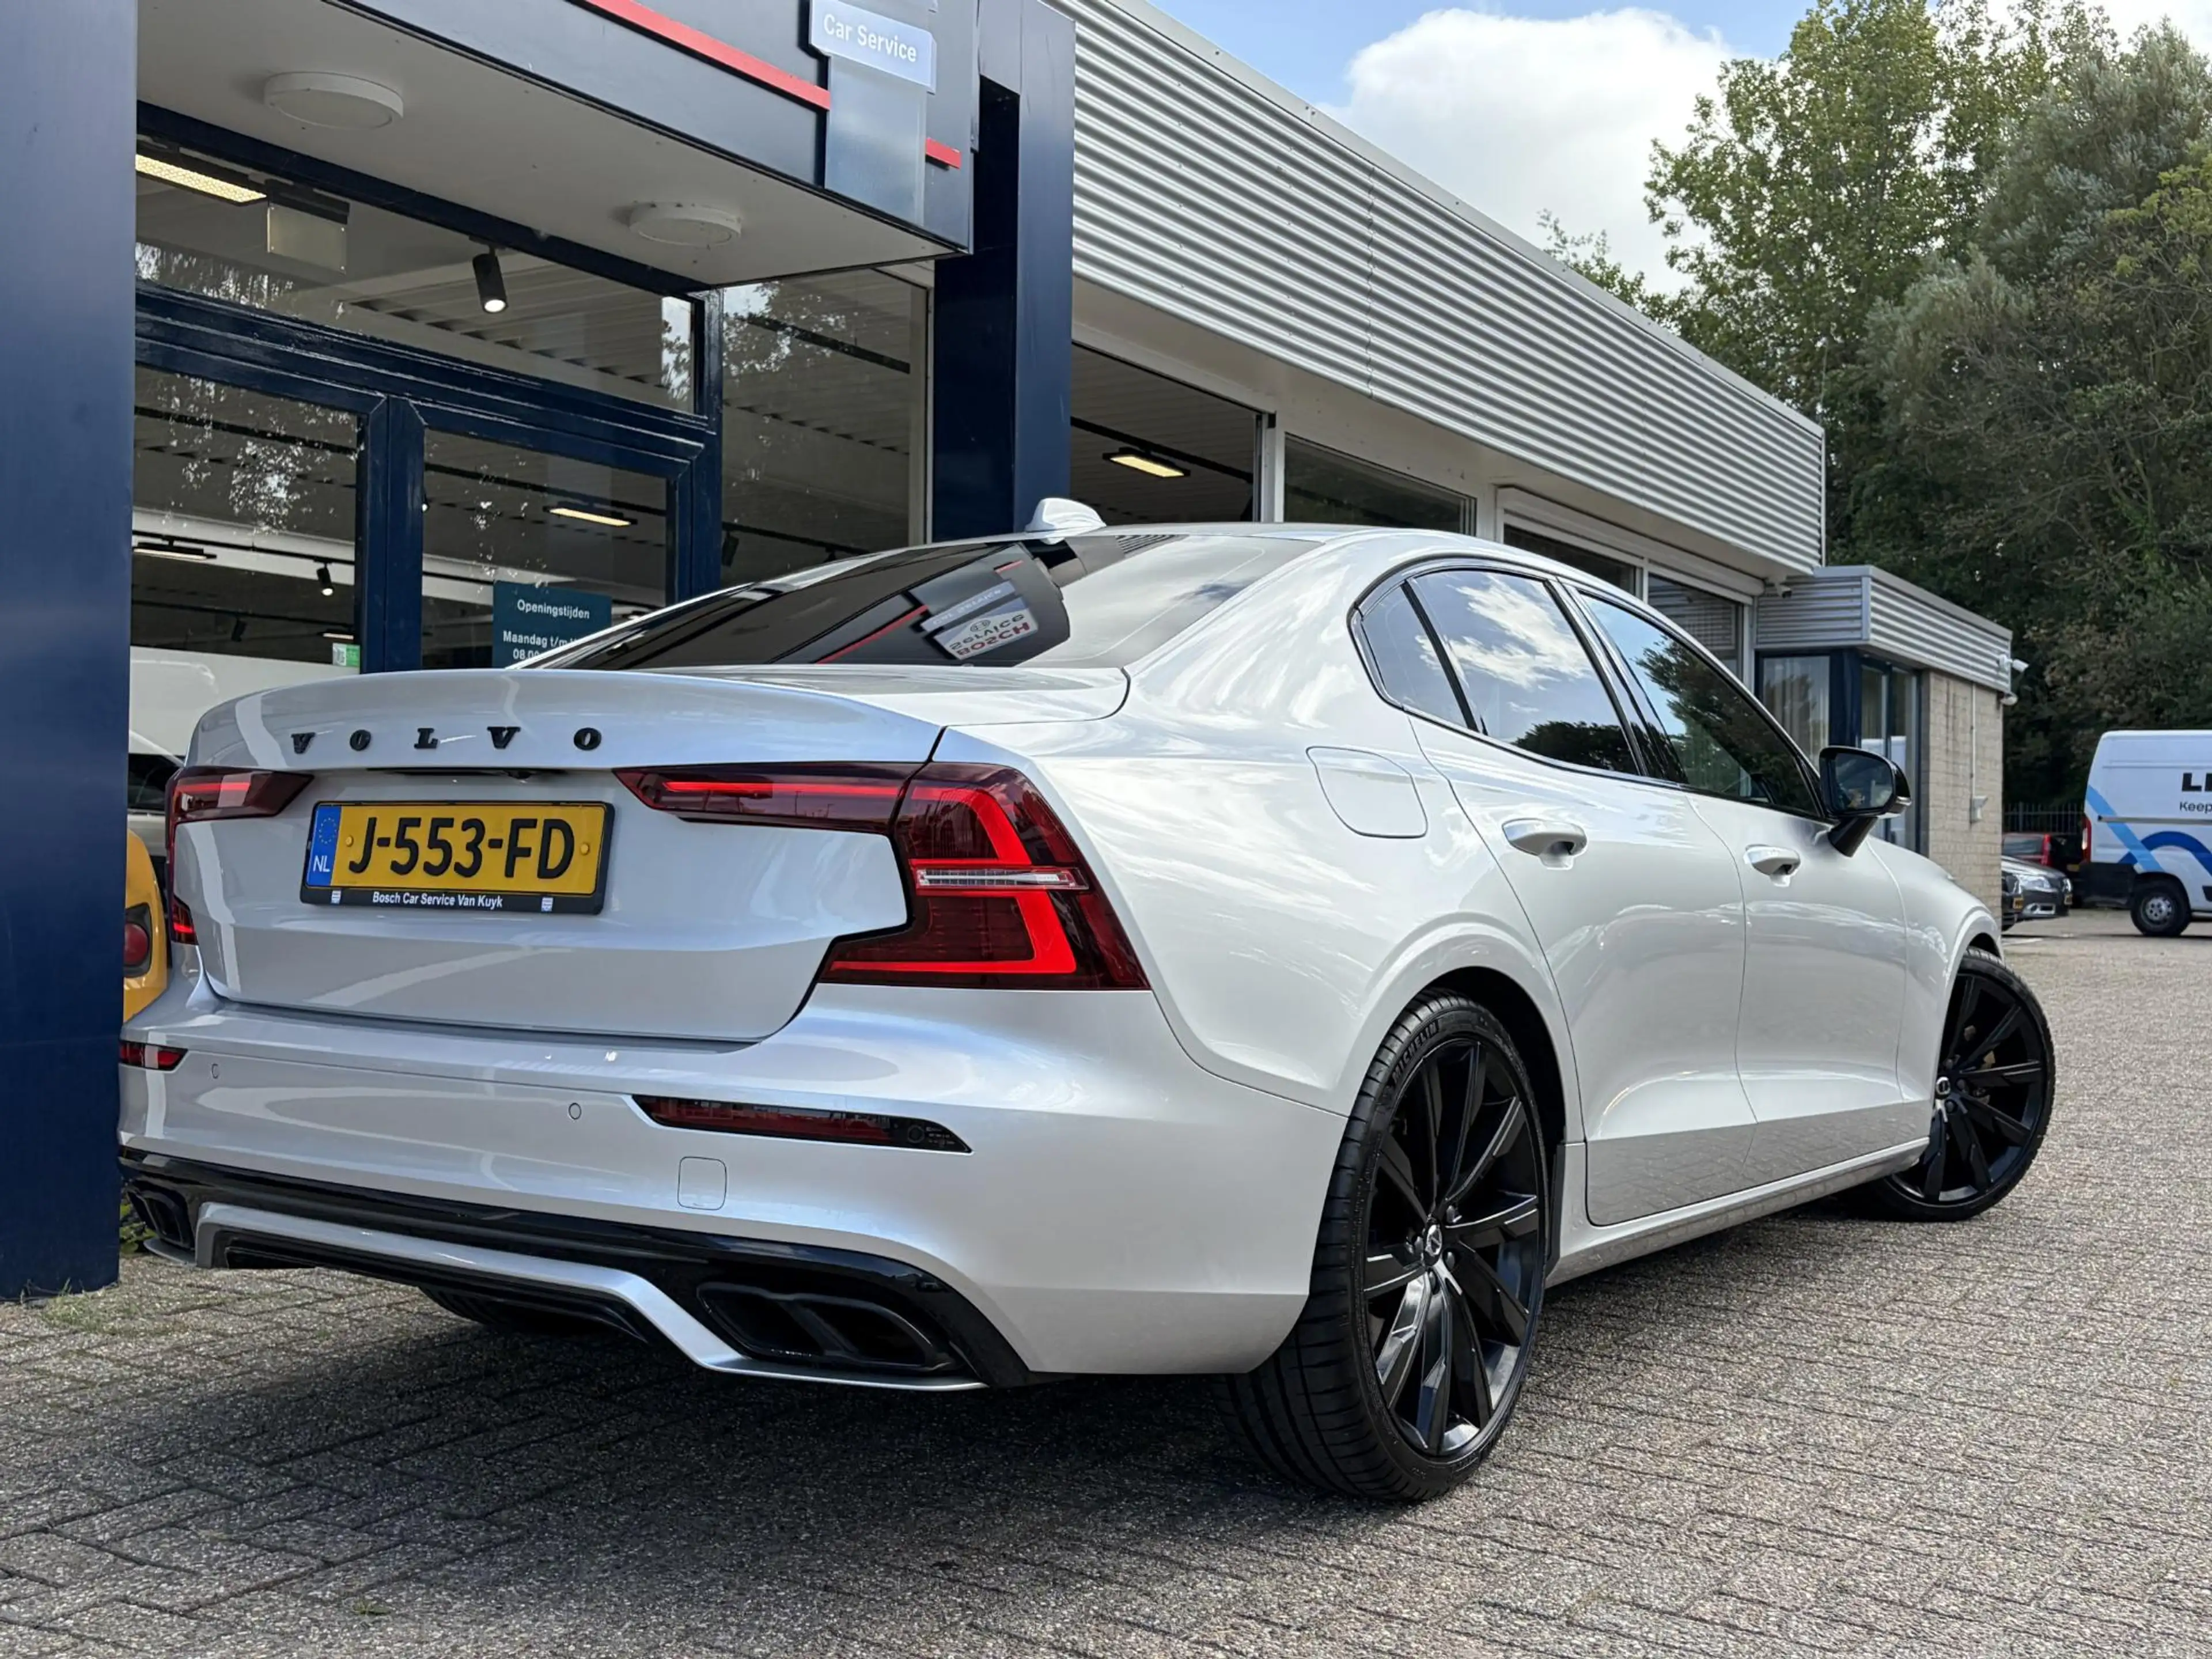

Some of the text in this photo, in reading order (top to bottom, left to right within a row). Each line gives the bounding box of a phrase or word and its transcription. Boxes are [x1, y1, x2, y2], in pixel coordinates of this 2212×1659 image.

[823, 13, 917, 62] Car Service
[517, 599, 590, 619] Openingstijden
[503, 630, 547, 648] Maandag
[290, 726, 602, 754] VOLVO
[348, 816, 575, 880] J-553-FD
[312, 854, 331, 873] NL
[372, 891, 503, 910] Bosch Car Service Van Kuyk
[1391, 1018, 1440, 1085] MICHELIN
